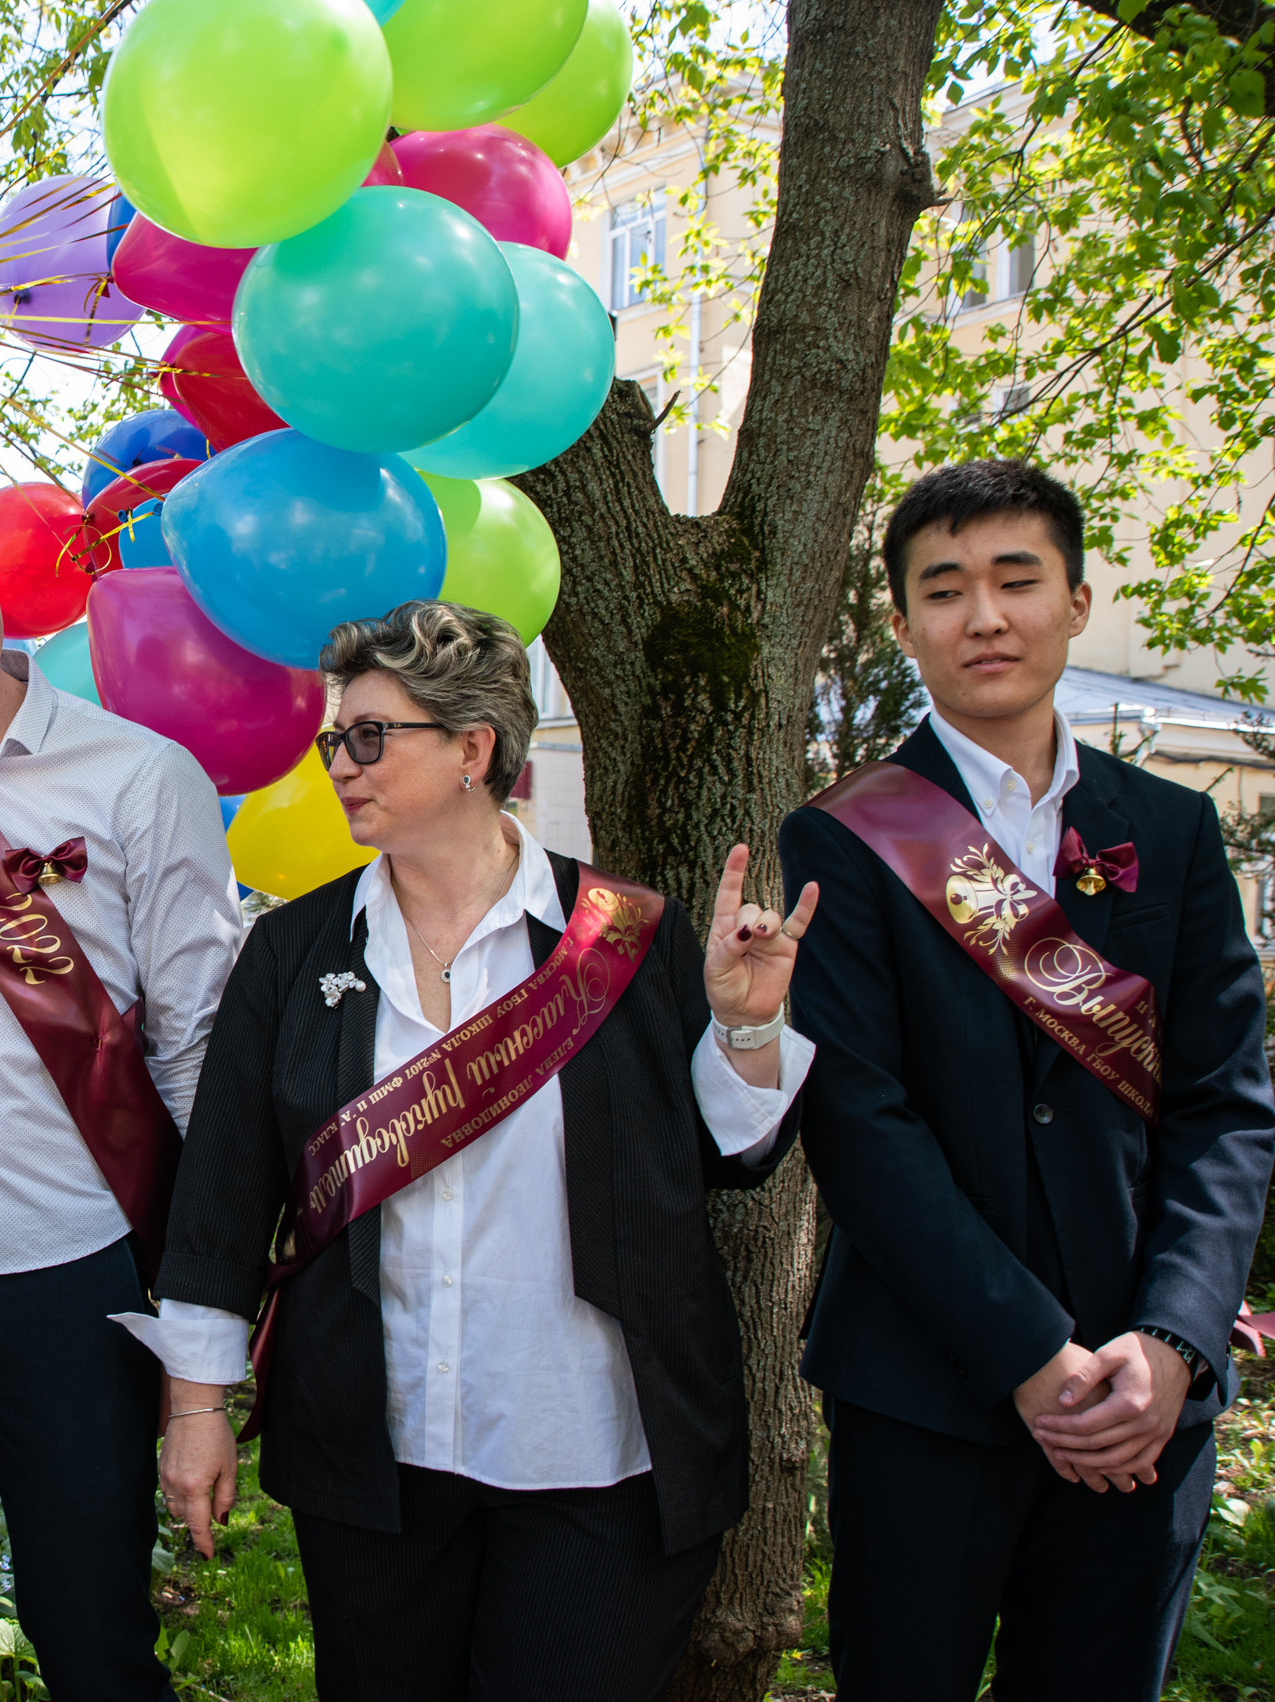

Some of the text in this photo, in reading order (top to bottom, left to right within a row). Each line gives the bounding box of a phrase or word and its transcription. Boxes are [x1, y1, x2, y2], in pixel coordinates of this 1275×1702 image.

[528, 948, 568, 990] МОСКВА
[496, 988, 529, 1018] ГБОУ
[441, 1016, 494, 1052] ШКОЛА
[310, 947, 610, 1213] Классный руководитель
[404, 1049, 442, 1080] №2107
[1035, 1009, 1088, 1055] МОСКВА
[1086, 1054, 1119, 1080] ГБОУ
[1117, 1080, 1154, 1117] ШКОЛА
[368, 1076, 403, 1104] ФМШ
[440, 1037, 575, 1148] ЕЛЕНА ЛЕОНИДОВНА
[308, 1124, 338, 1156] КЛАСС
